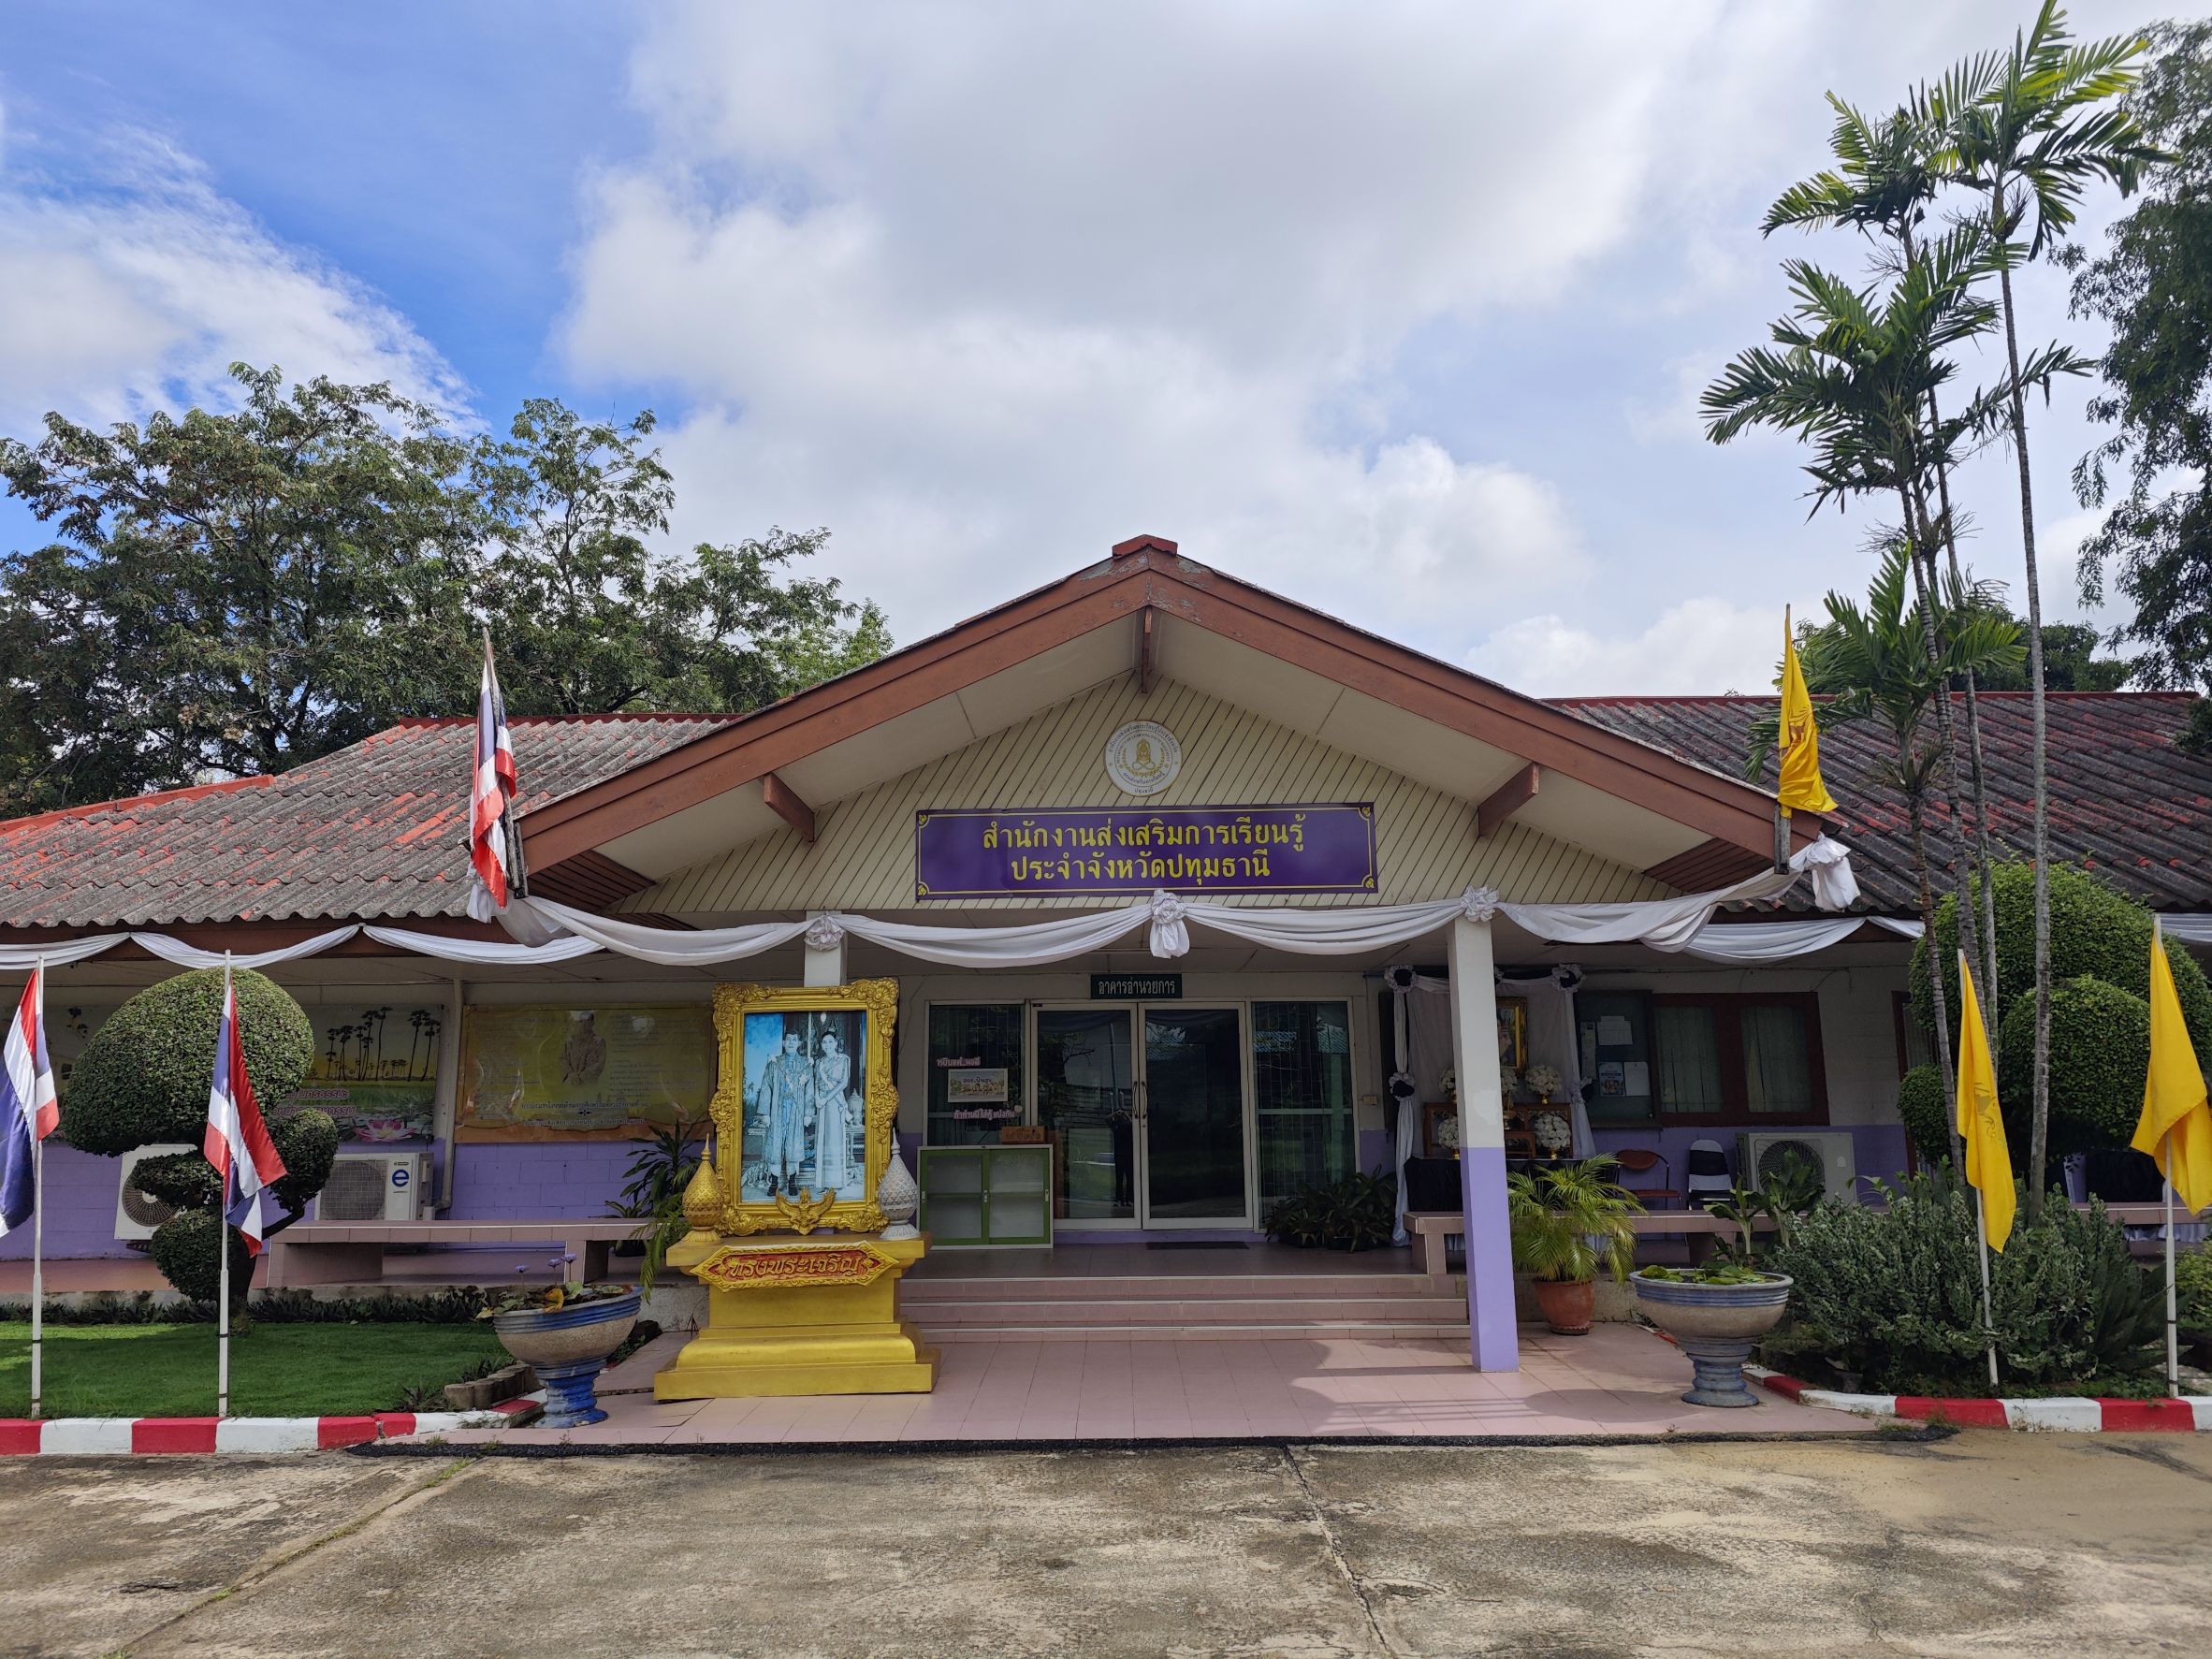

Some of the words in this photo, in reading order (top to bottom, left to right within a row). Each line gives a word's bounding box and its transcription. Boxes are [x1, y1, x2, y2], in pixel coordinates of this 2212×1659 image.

[982, 813, 1306, 852] สำนักงานส่งเสริมการเรียนรู้
[1011, 849, 1271, 886] ประจำจังหวัดปทุมธานี
[1098, 976, 1175, 995] อาคารอำนวยการ
[730, 1253, 859, 1276] ทรงพระเจริญ
